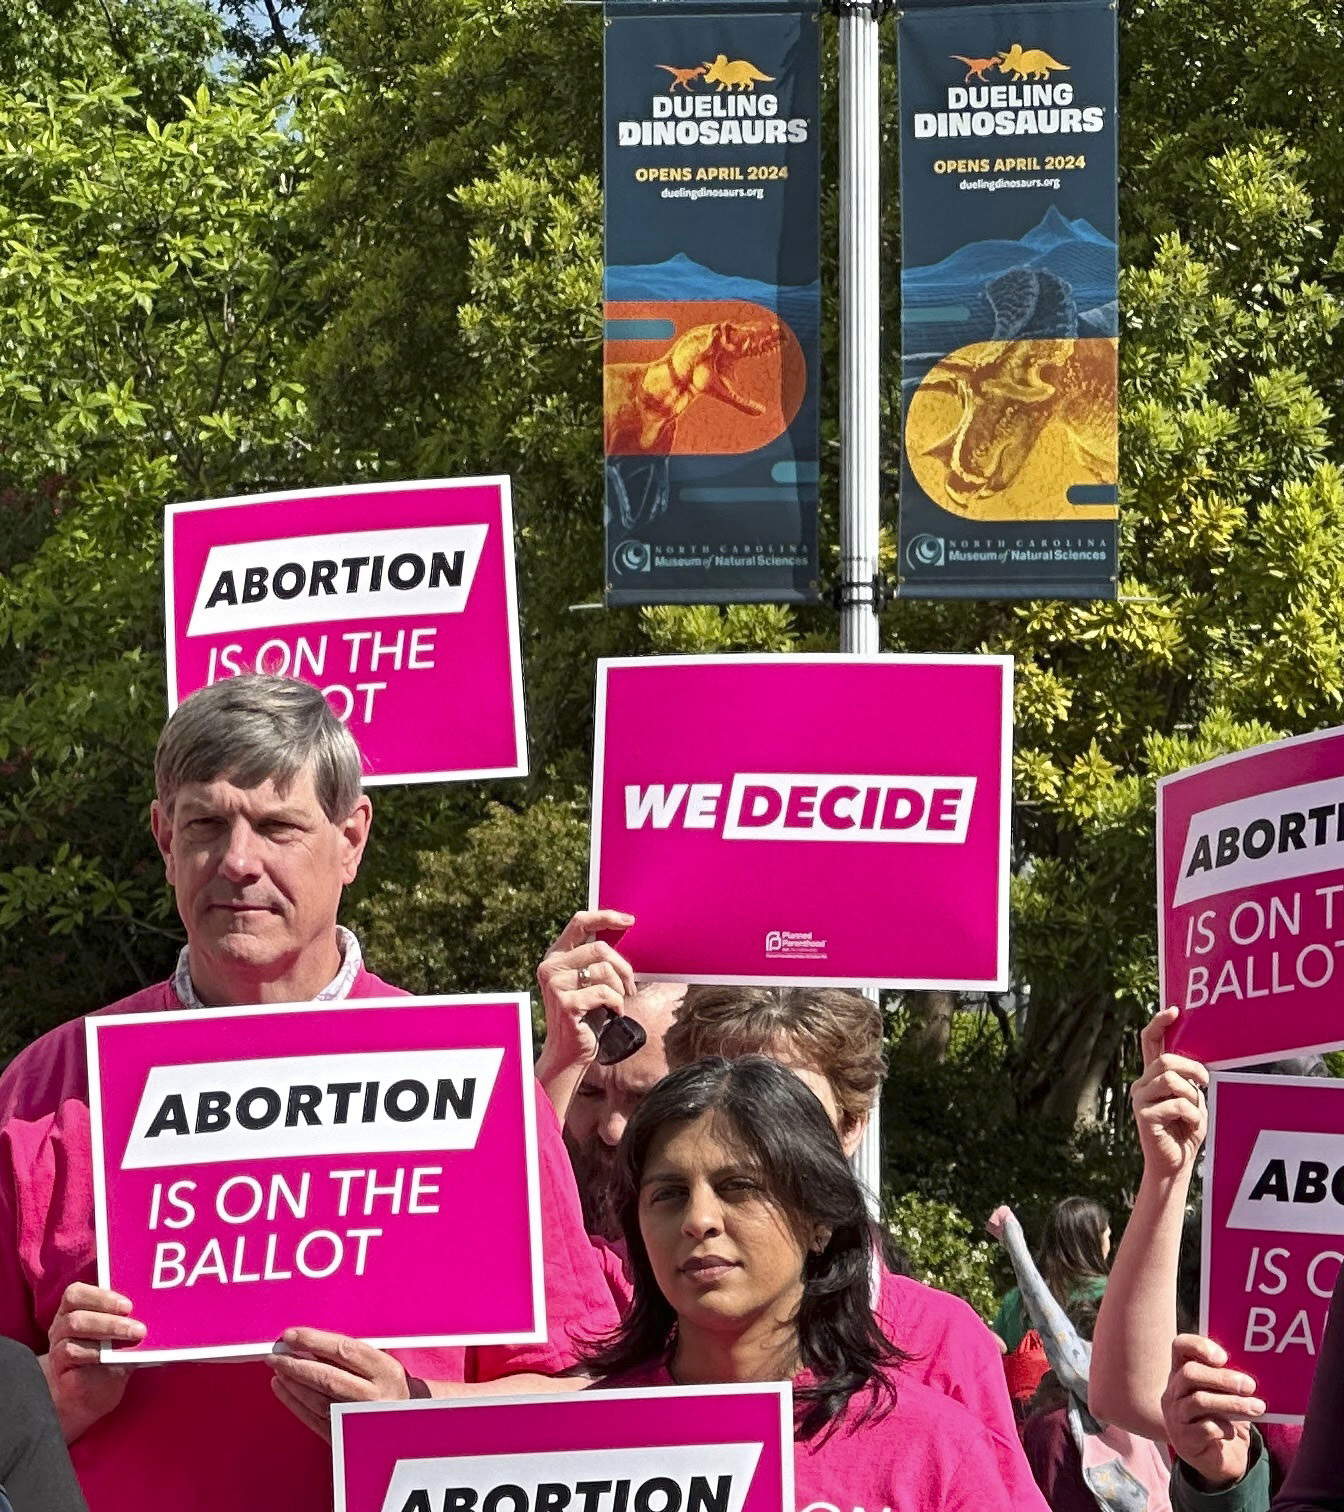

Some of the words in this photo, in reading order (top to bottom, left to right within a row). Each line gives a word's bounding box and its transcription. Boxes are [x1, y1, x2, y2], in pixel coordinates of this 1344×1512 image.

[653, 94, 778, 118] DUELING
[948, 83, 1073, 110] DUELING
[618, 118, 808, 146] DINOSAURS
[914, 107, 1104, 138] DINOSAURS
[635, 168, 692, 182] OPENS
[696, 167, 743, 181] APRIL
[746, 166, 789, 180] 2024
[933, 159, 990, 174] OPENS
[993, 157, 1041, 173] APRIL
[1044, 155, 1086, 170] 2024
[661, 187, 764, 200] duelingdinosaurs.org
[960, 178, 1060, 192] duelingdinosaurs.org
[656, 545, 710, 554] NORTH
[720, 545, 808, 554] CAROLINA
[949, 540, 1006, 548] NORTH
[1016, 539, 1106, 548] CAROLINA
[949, 550, 998, 562] Museum
[998, 548, 1010, 564] of
[1011, 549, 1053, 561] Natural
[1055, 548, 1106, 561] Sciences
[656, 556, 702, 567] Museum
[703, 554, 715, 569] of
[715, 555, 756, 567] Natural
[757, 554, 808, 566] Sciences
[204, 550, 466, 608] ABORTION
[207, 644, 243, 686] IS
[255, 635, 328, 678] ON
[342, 628, 438, 673] THE
[624, 783, 723, 830] WE
[737, 785, 964, 832] DECIDE
[1185, 910, 1217, 958] IS
[1229, 891, 1302, 946] ON
[144, 1077, 477, 1138] ABORTION
[148, 1179, 197, 1230] IS
[215, 1172, 311, 1224] ON
[329, 1166, 443, 1217] THE
[151, 1228, 383, 1289] BALLOT
[1244, 1247, 1291, 1295] IS
